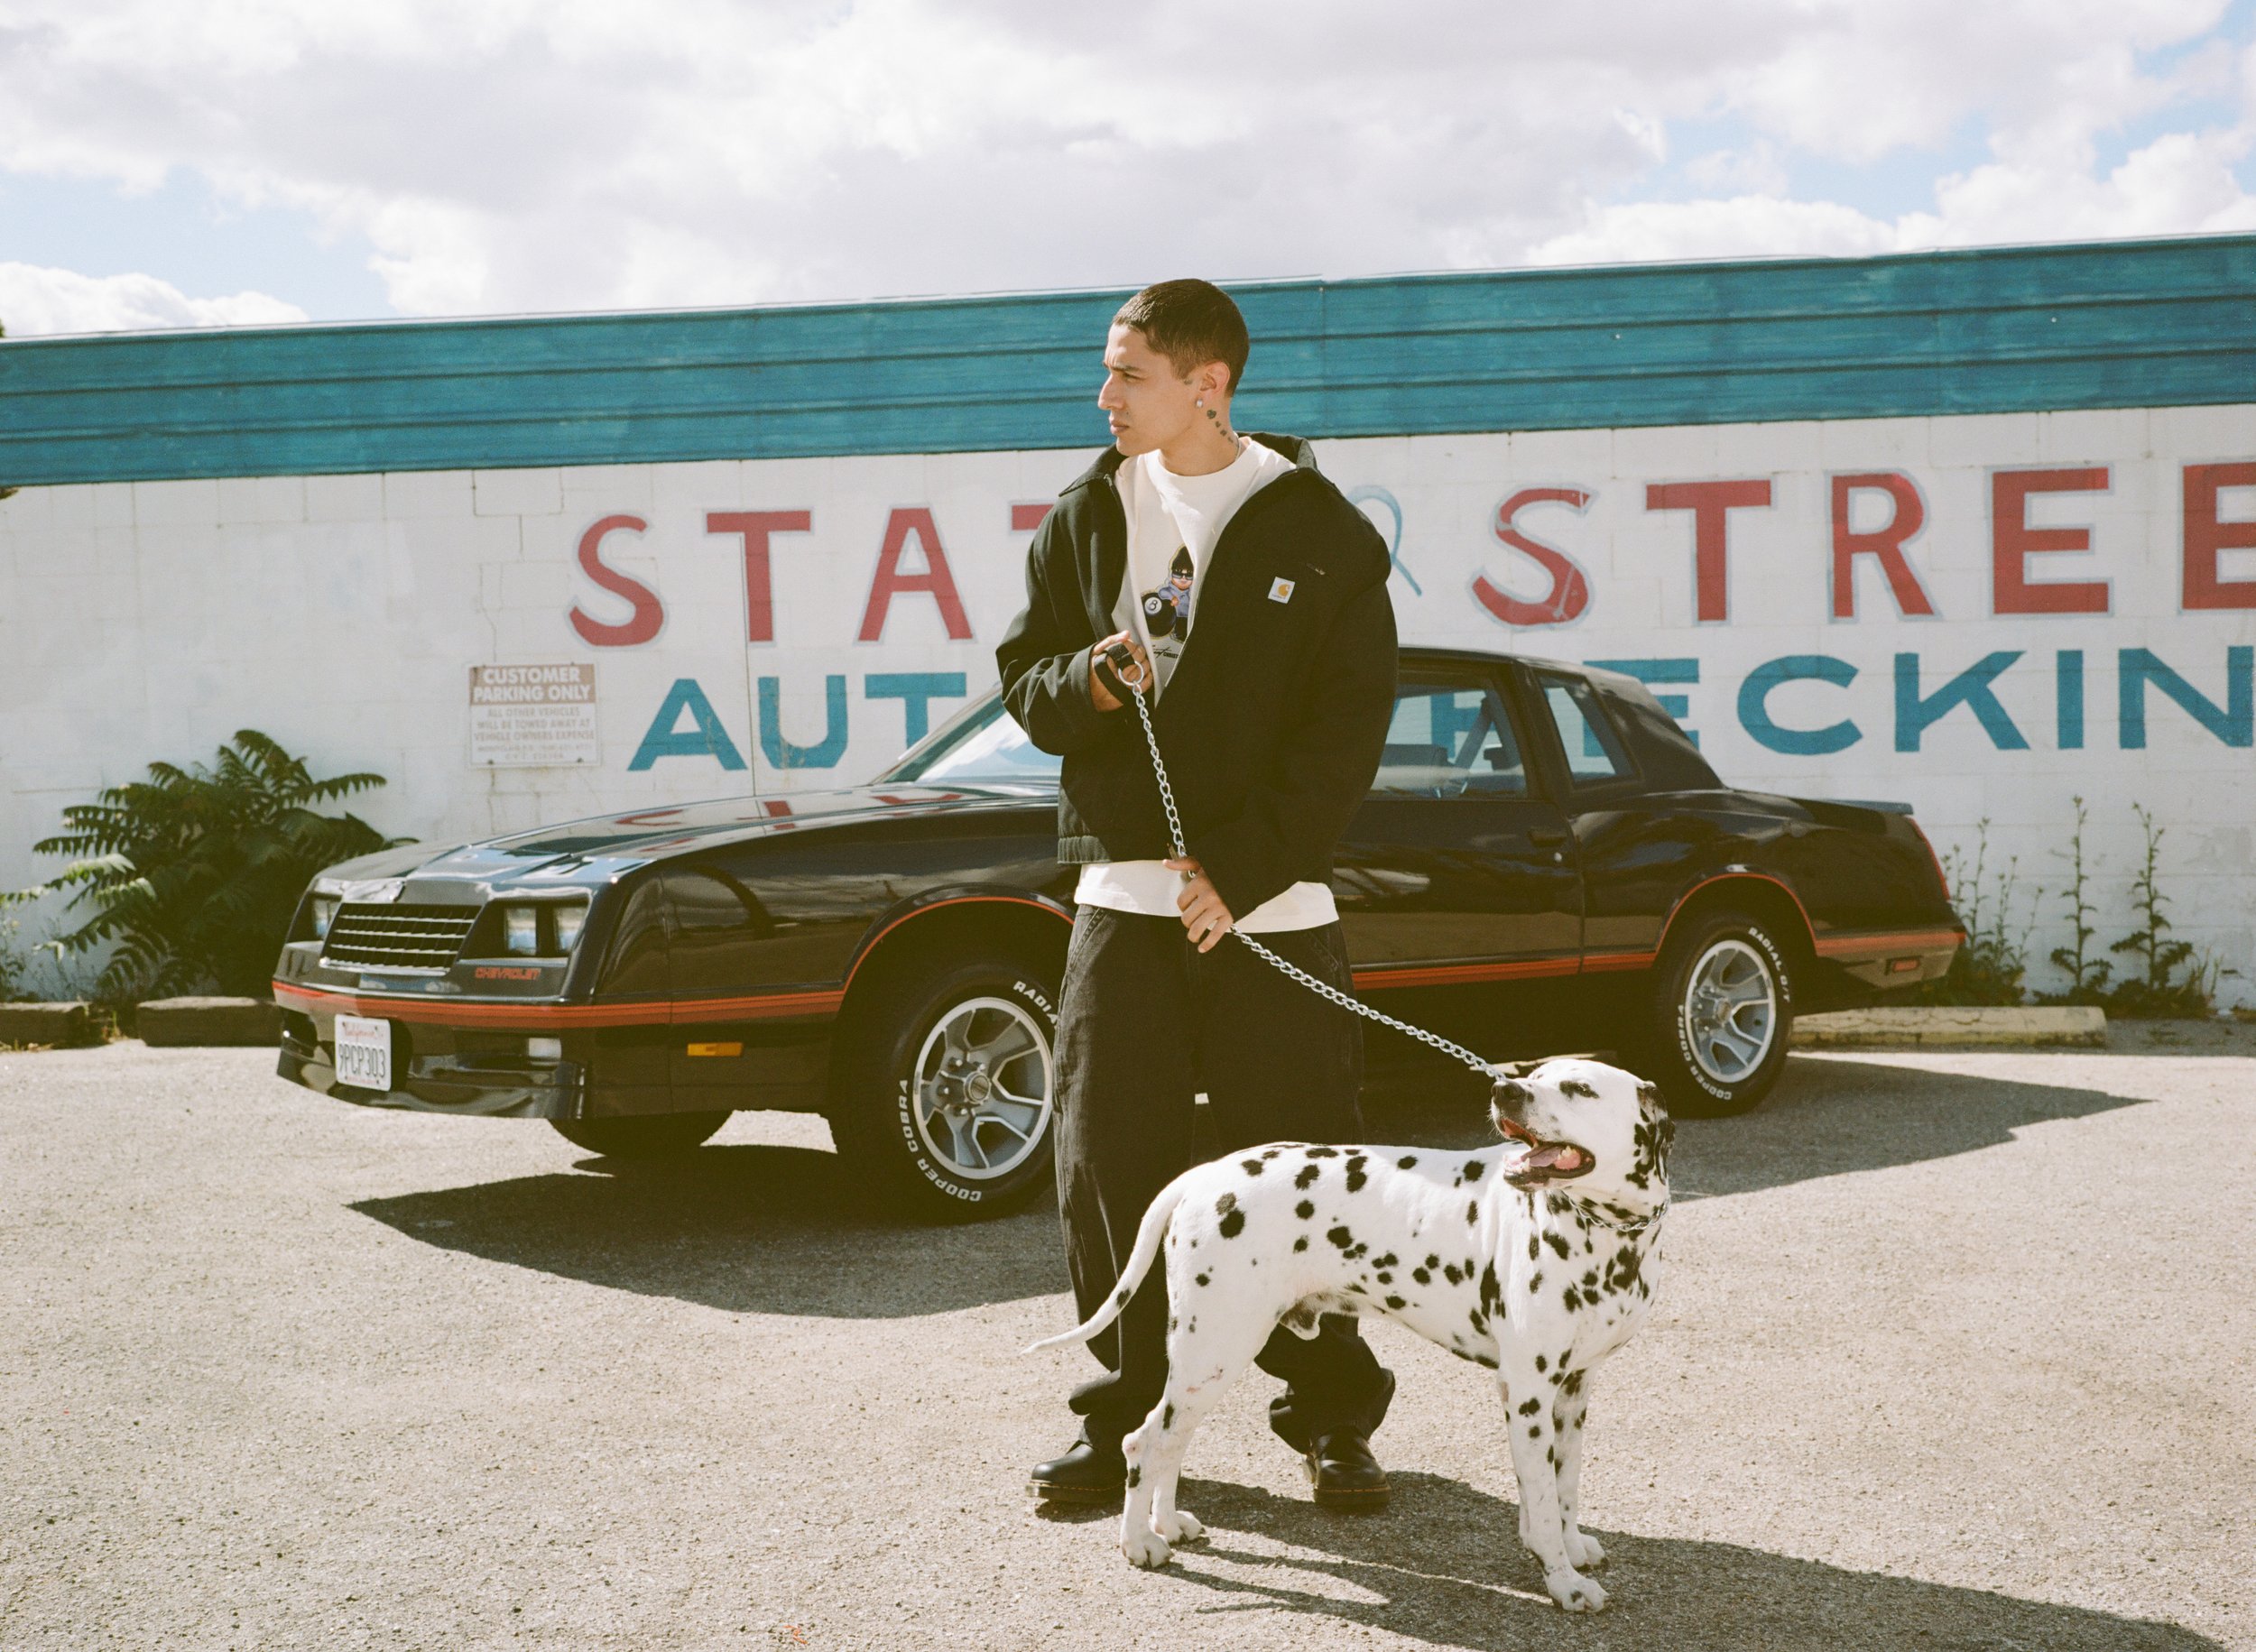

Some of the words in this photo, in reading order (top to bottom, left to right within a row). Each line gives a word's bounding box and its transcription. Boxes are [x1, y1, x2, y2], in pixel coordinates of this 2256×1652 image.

[1470, 462, 2256, 626] STREE
[483, 666, 580, 685] CUSTOMER
[473, 685, 544, 703] PARKING
[548, 683, 592, 701] ONLY
[505, 707, 535, 717] OTHER
[539, 706, 580, 716] VEHICLES
[515, 719, 548, 729] TOWED
[550, 718, 577, 728] AWAY
[579, 717, 590, 727] AT
[473, 731, 511, 742] VEHICLE
[556, 730, 595, 740] EXPENSE
[1749, 927, 1782, 972] RADIAL
[476, 966, 542, 981] CHEVROLET
[1678, 1004, 1692, 1062] COBRA
[338, 1043, 386, 1078] 9PCP303
[1690, 1066, 1733, 1100] COOPER
[899, 1079, 919, 1153] COBRA
[917, 1158, 983, 1203] COOPER
